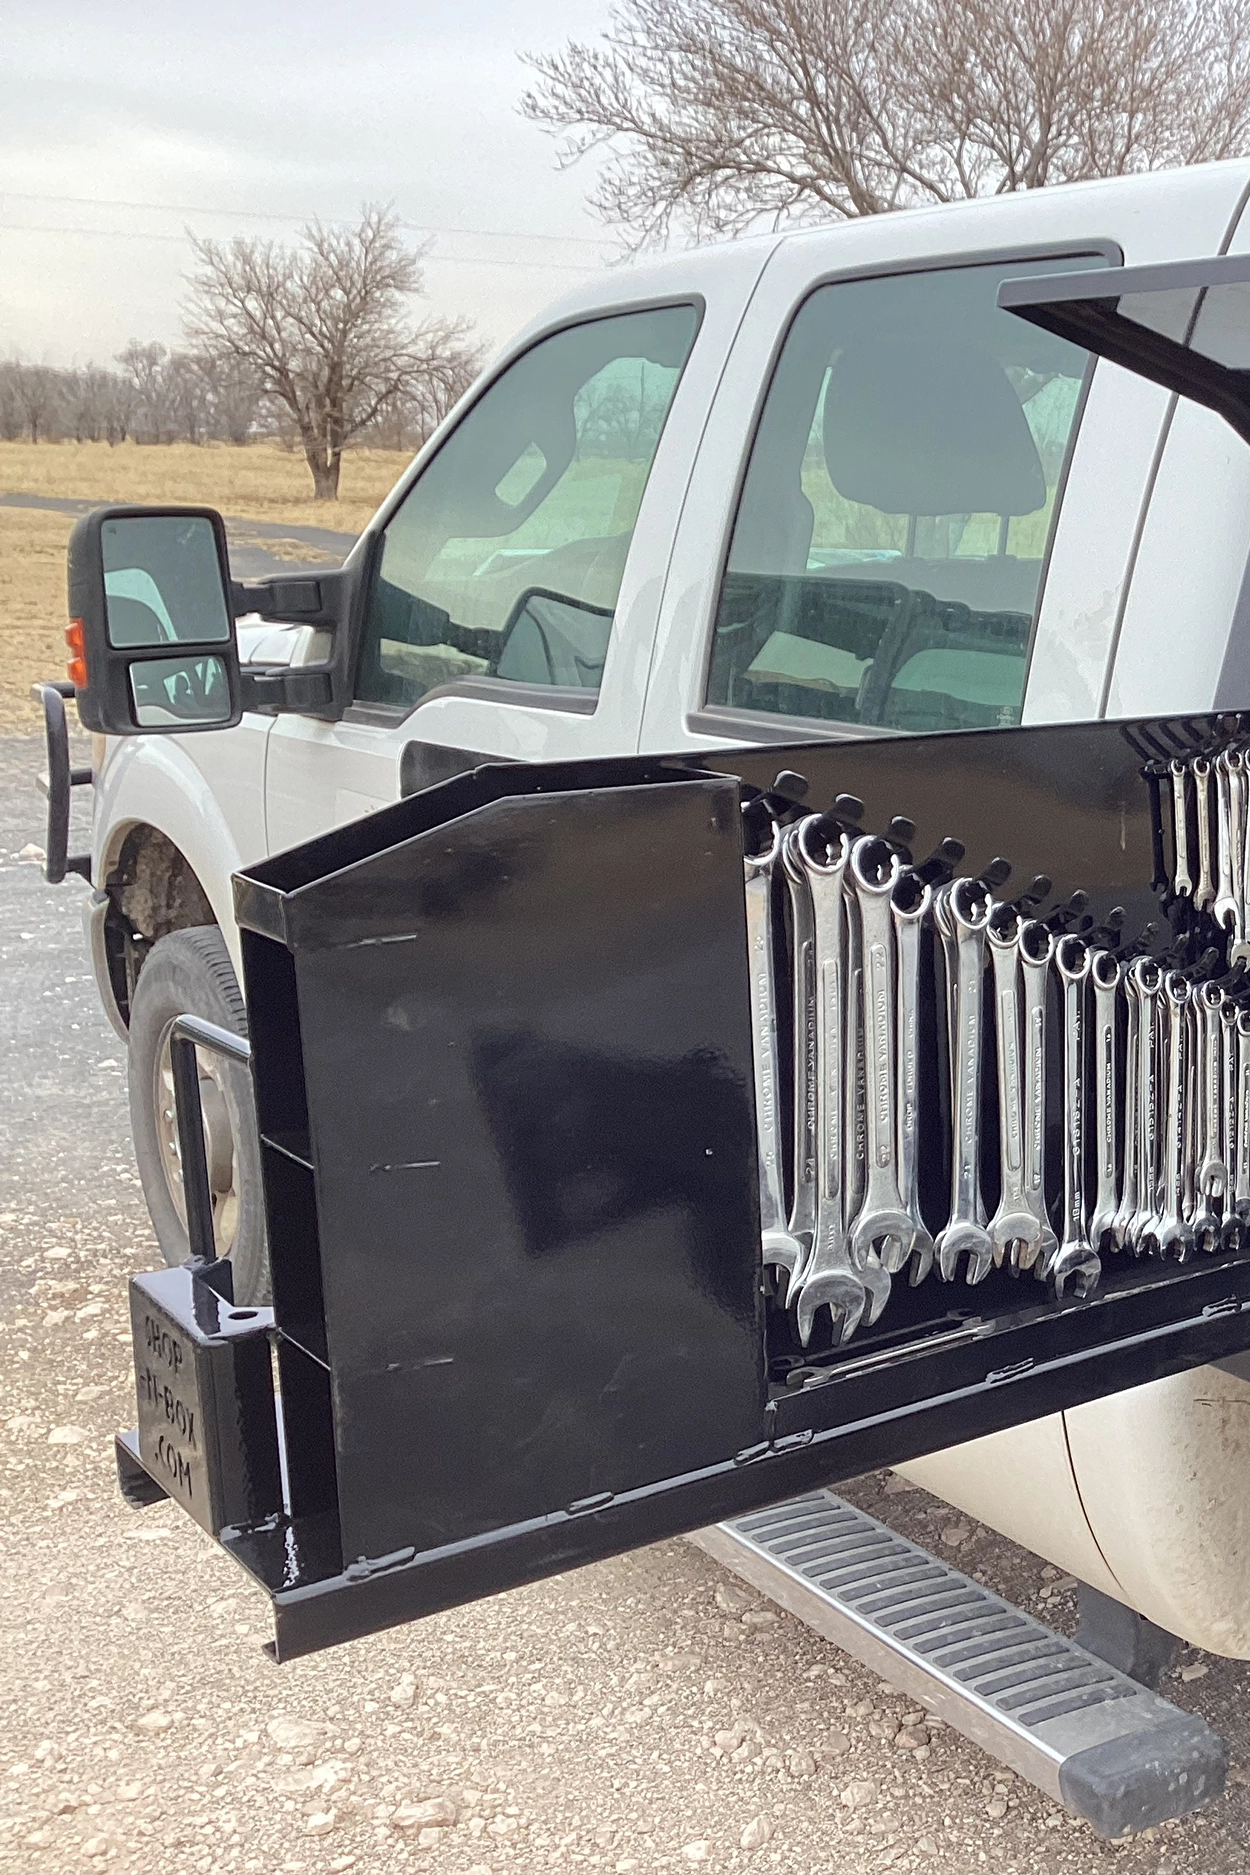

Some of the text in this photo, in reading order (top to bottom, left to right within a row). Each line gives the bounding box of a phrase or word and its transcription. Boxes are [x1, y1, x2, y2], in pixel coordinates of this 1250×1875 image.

[758, 972, 772, 1059] VANADIUM
[807, 995, 816, 1071] VANADIUM
[876, 989, 886, 1061] VANADIUM
[967, 1015, 977, 1084] VANADIUM
[761, 1061, 774, 1133] CHROME
[807, 1071, 815, 1130] CHROME
[878, 1062, 888, 1124] CHROME
[965, 1090, 974, 1144] CHROME
[1010, 1097, 1018, 1139] CHROME
[857, 1104, 865, 1160] CHROME
[1034, 1105, 1042, 1151] CHROME
[154, 1435, 193, 1500] .COM
